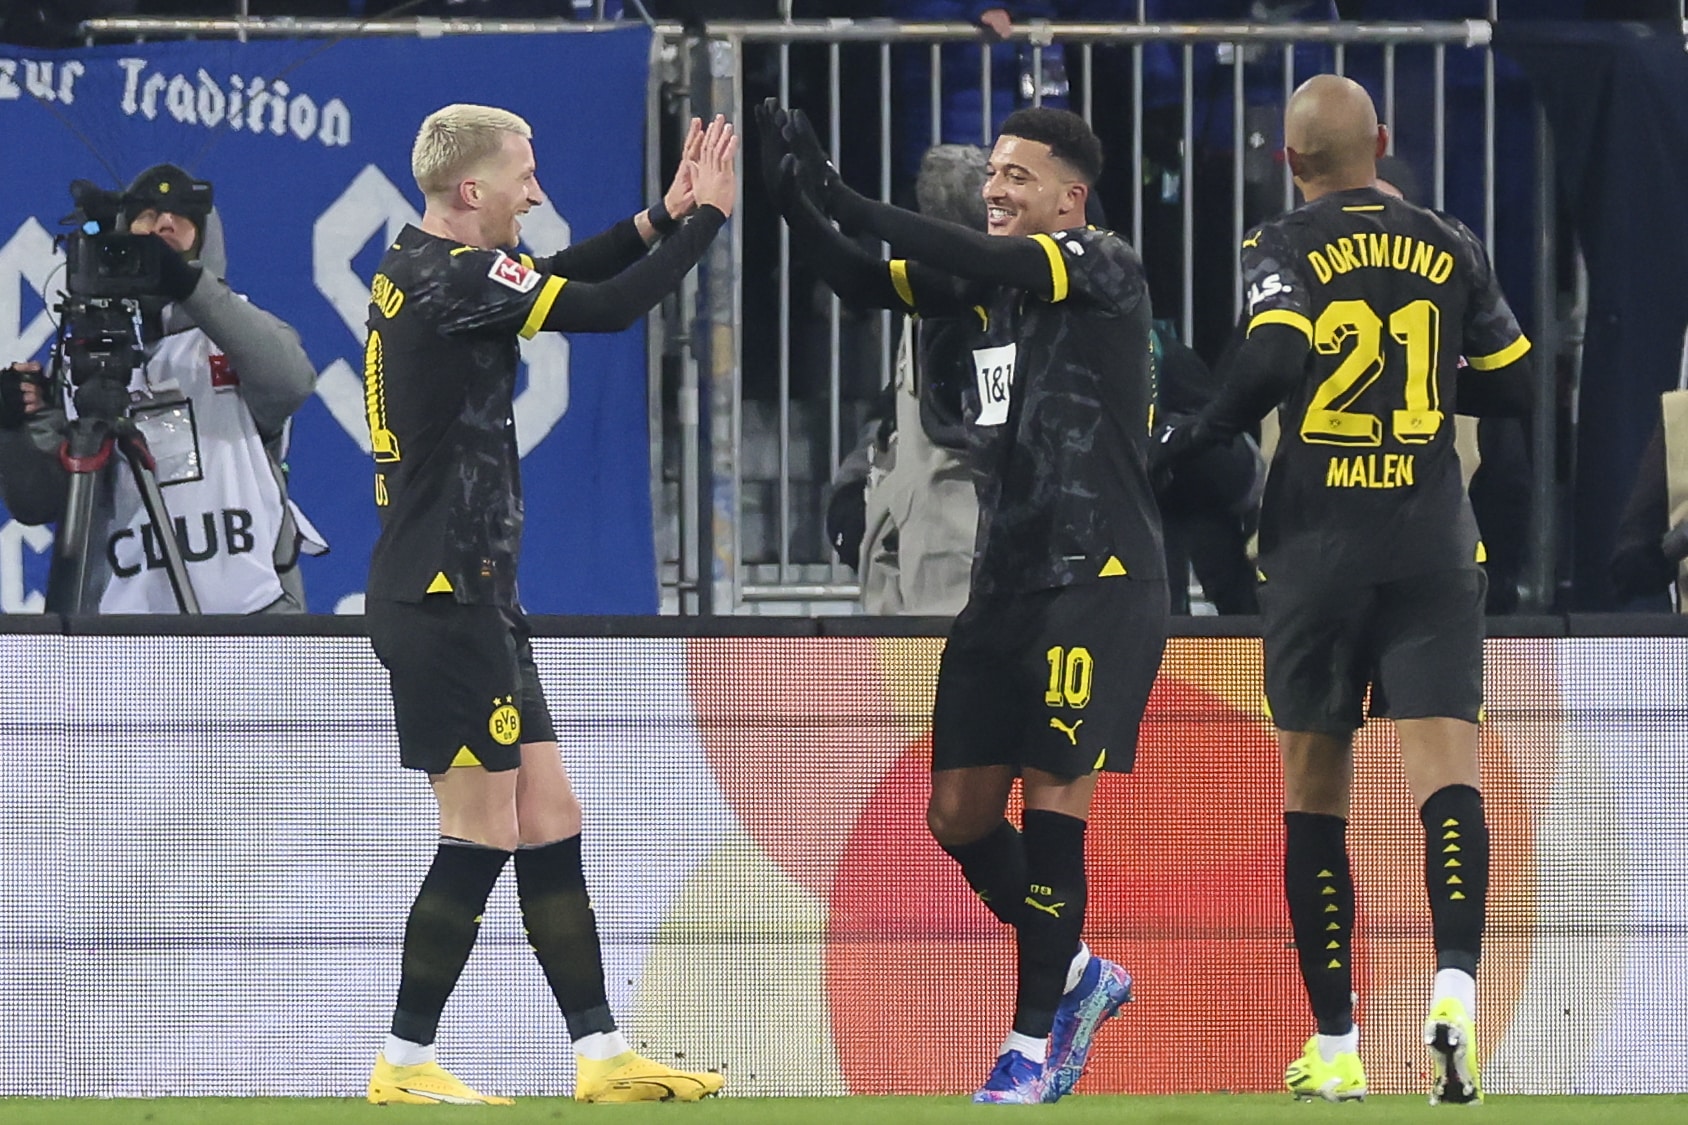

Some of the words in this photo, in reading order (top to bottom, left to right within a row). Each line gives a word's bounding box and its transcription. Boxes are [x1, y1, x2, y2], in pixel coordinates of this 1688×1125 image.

[118, 57, 350, 147] Tradition
[1307, 233, 1454, 285] DORTMUND
[981, 363, 1013, 405] 1&1
[1300, 299, 1444, 447] 21
[1326, 453, 1415, 489] MALEN
[107, 508, 255, 578] CLUB
[1045, 645, 1094, 709] 10
[494, 709, 517, 734] BVB
